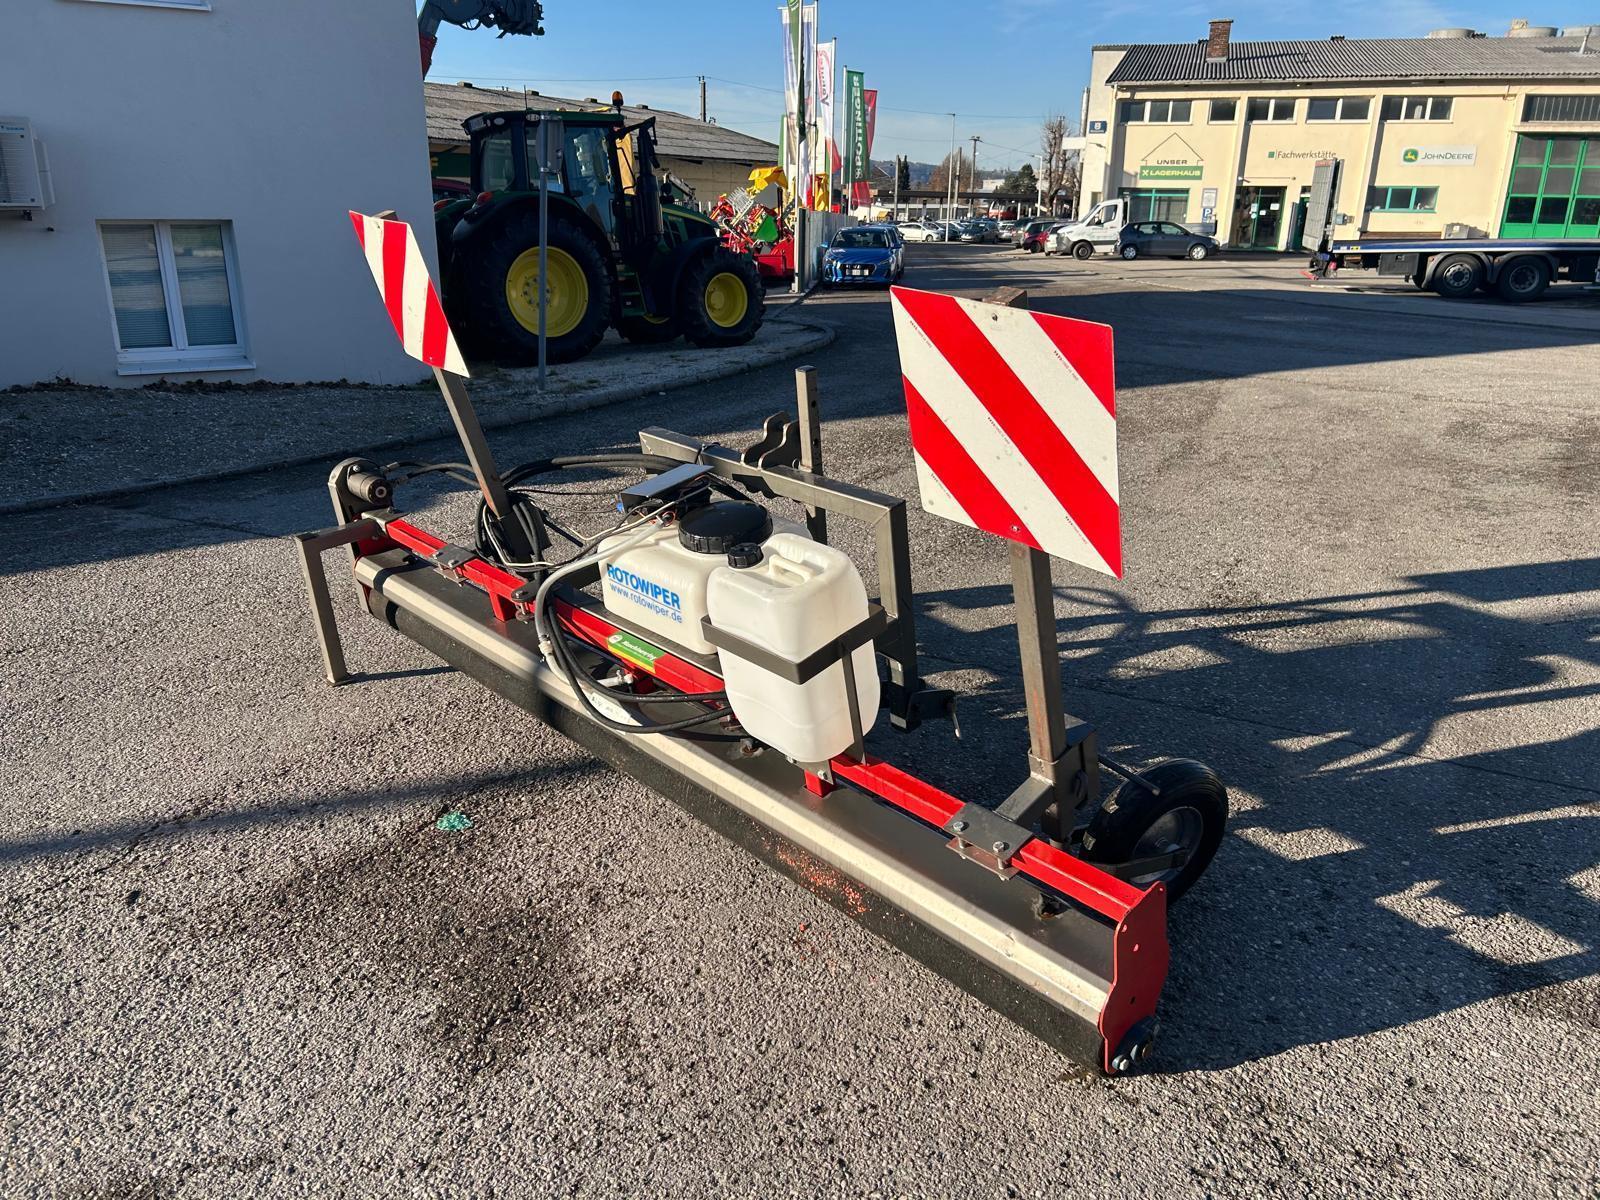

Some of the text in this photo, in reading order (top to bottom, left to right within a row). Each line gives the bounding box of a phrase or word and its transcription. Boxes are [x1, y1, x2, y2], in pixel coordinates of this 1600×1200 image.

[1277, 150, 1337, 159] Fachwerkstätte
[607, 563, 681, 609] ROTOWIPER
[610, 583, 682, 623] www.rotowiper.de
